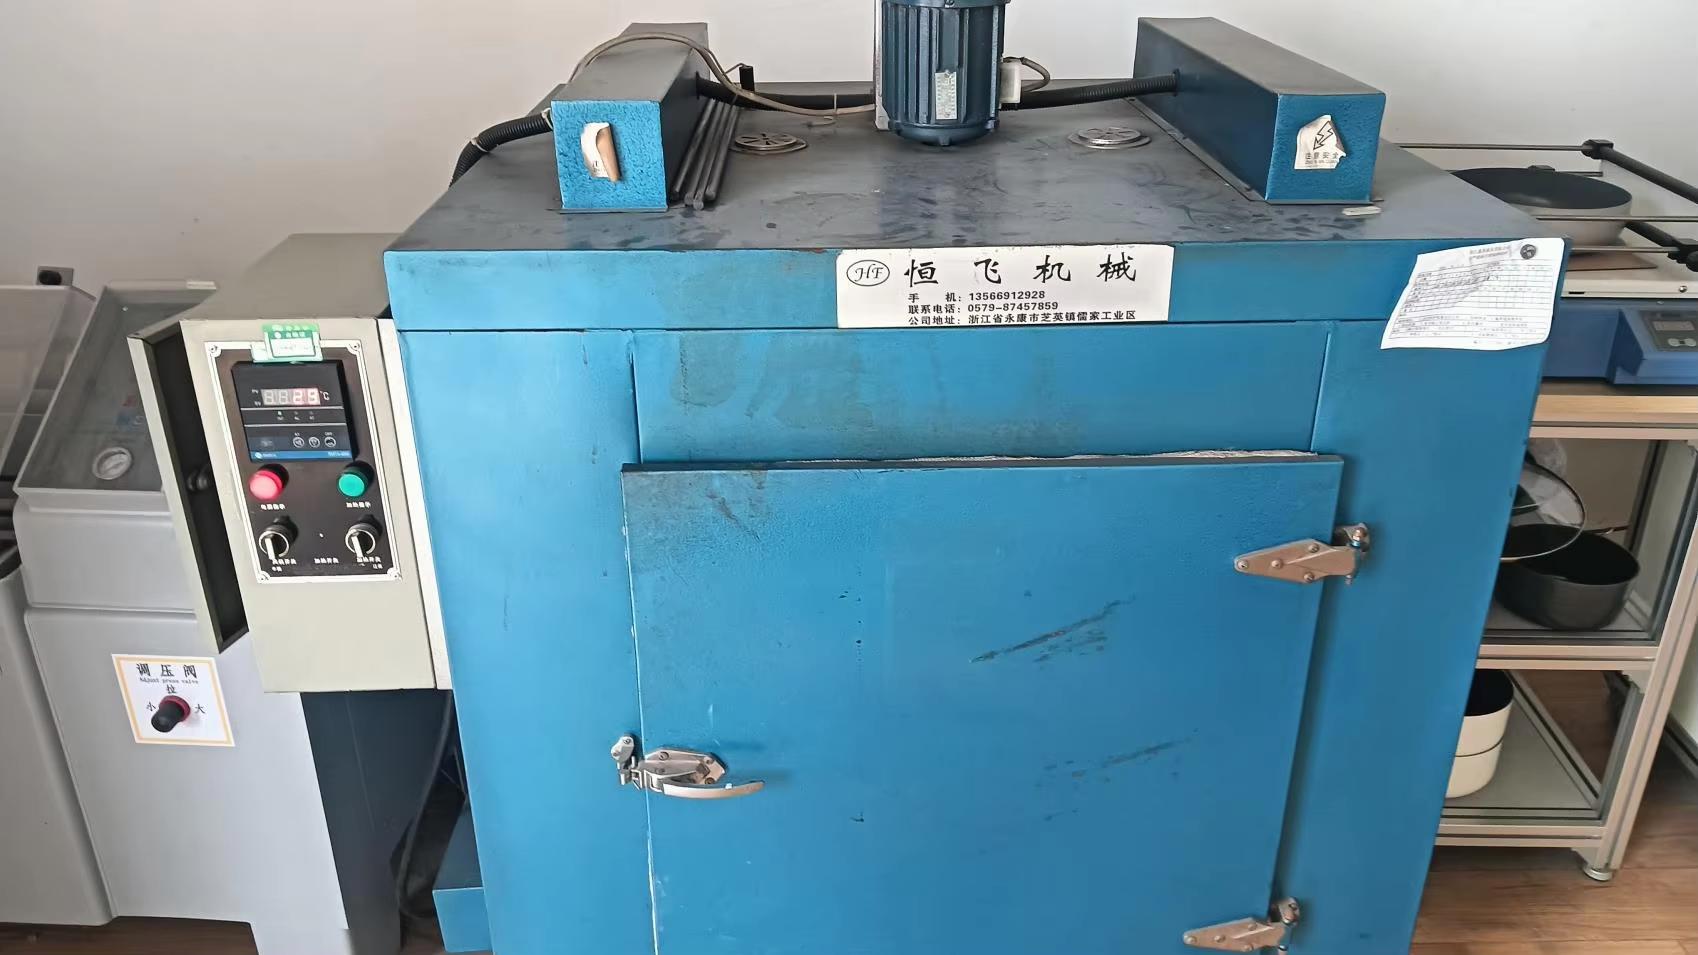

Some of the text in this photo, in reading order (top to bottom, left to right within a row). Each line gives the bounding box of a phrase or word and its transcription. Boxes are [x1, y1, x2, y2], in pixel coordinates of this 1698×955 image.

[904, 252, 1137, 287] 恒飞机械
[968, 290, 1046, 301] 13566912928
[967, 301, 1059, 312] 0579-87457859
[968, 310, 1136, 325] 浙江省永康市芝英镇儒家工业区
[136, 663, 197, 679] 调压阀
[146, 701, 156, 711] 小
[194, 703, 205, 714] 大
